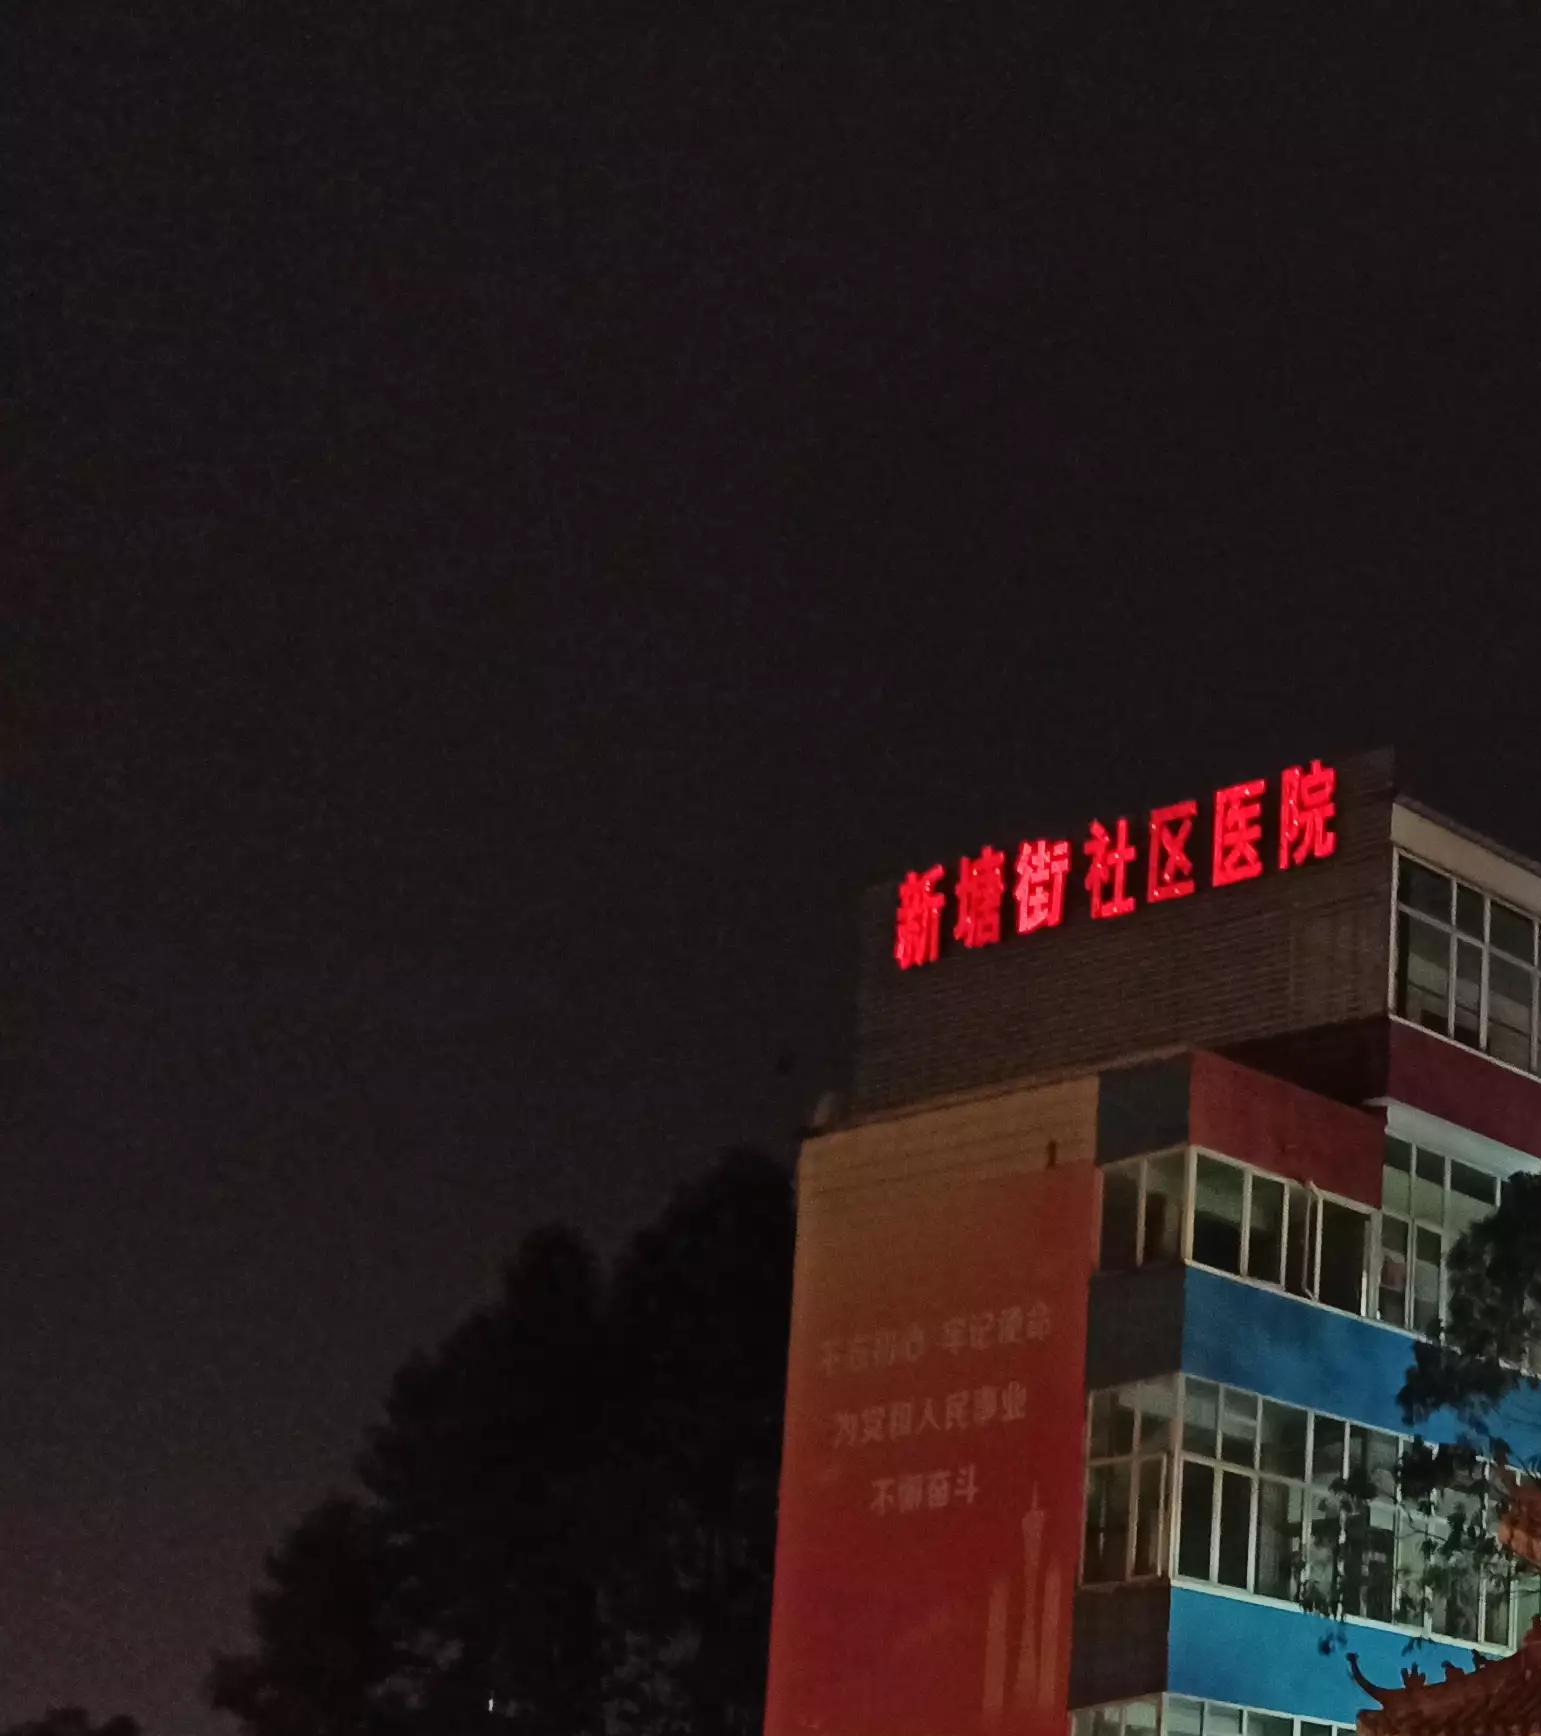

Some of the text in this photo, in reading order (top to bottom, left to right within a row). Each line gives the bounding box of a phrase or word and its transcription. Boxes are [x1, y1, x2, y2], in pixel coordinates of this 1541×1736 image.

[893, 758, 1340, 971] 新塘街社区医院
